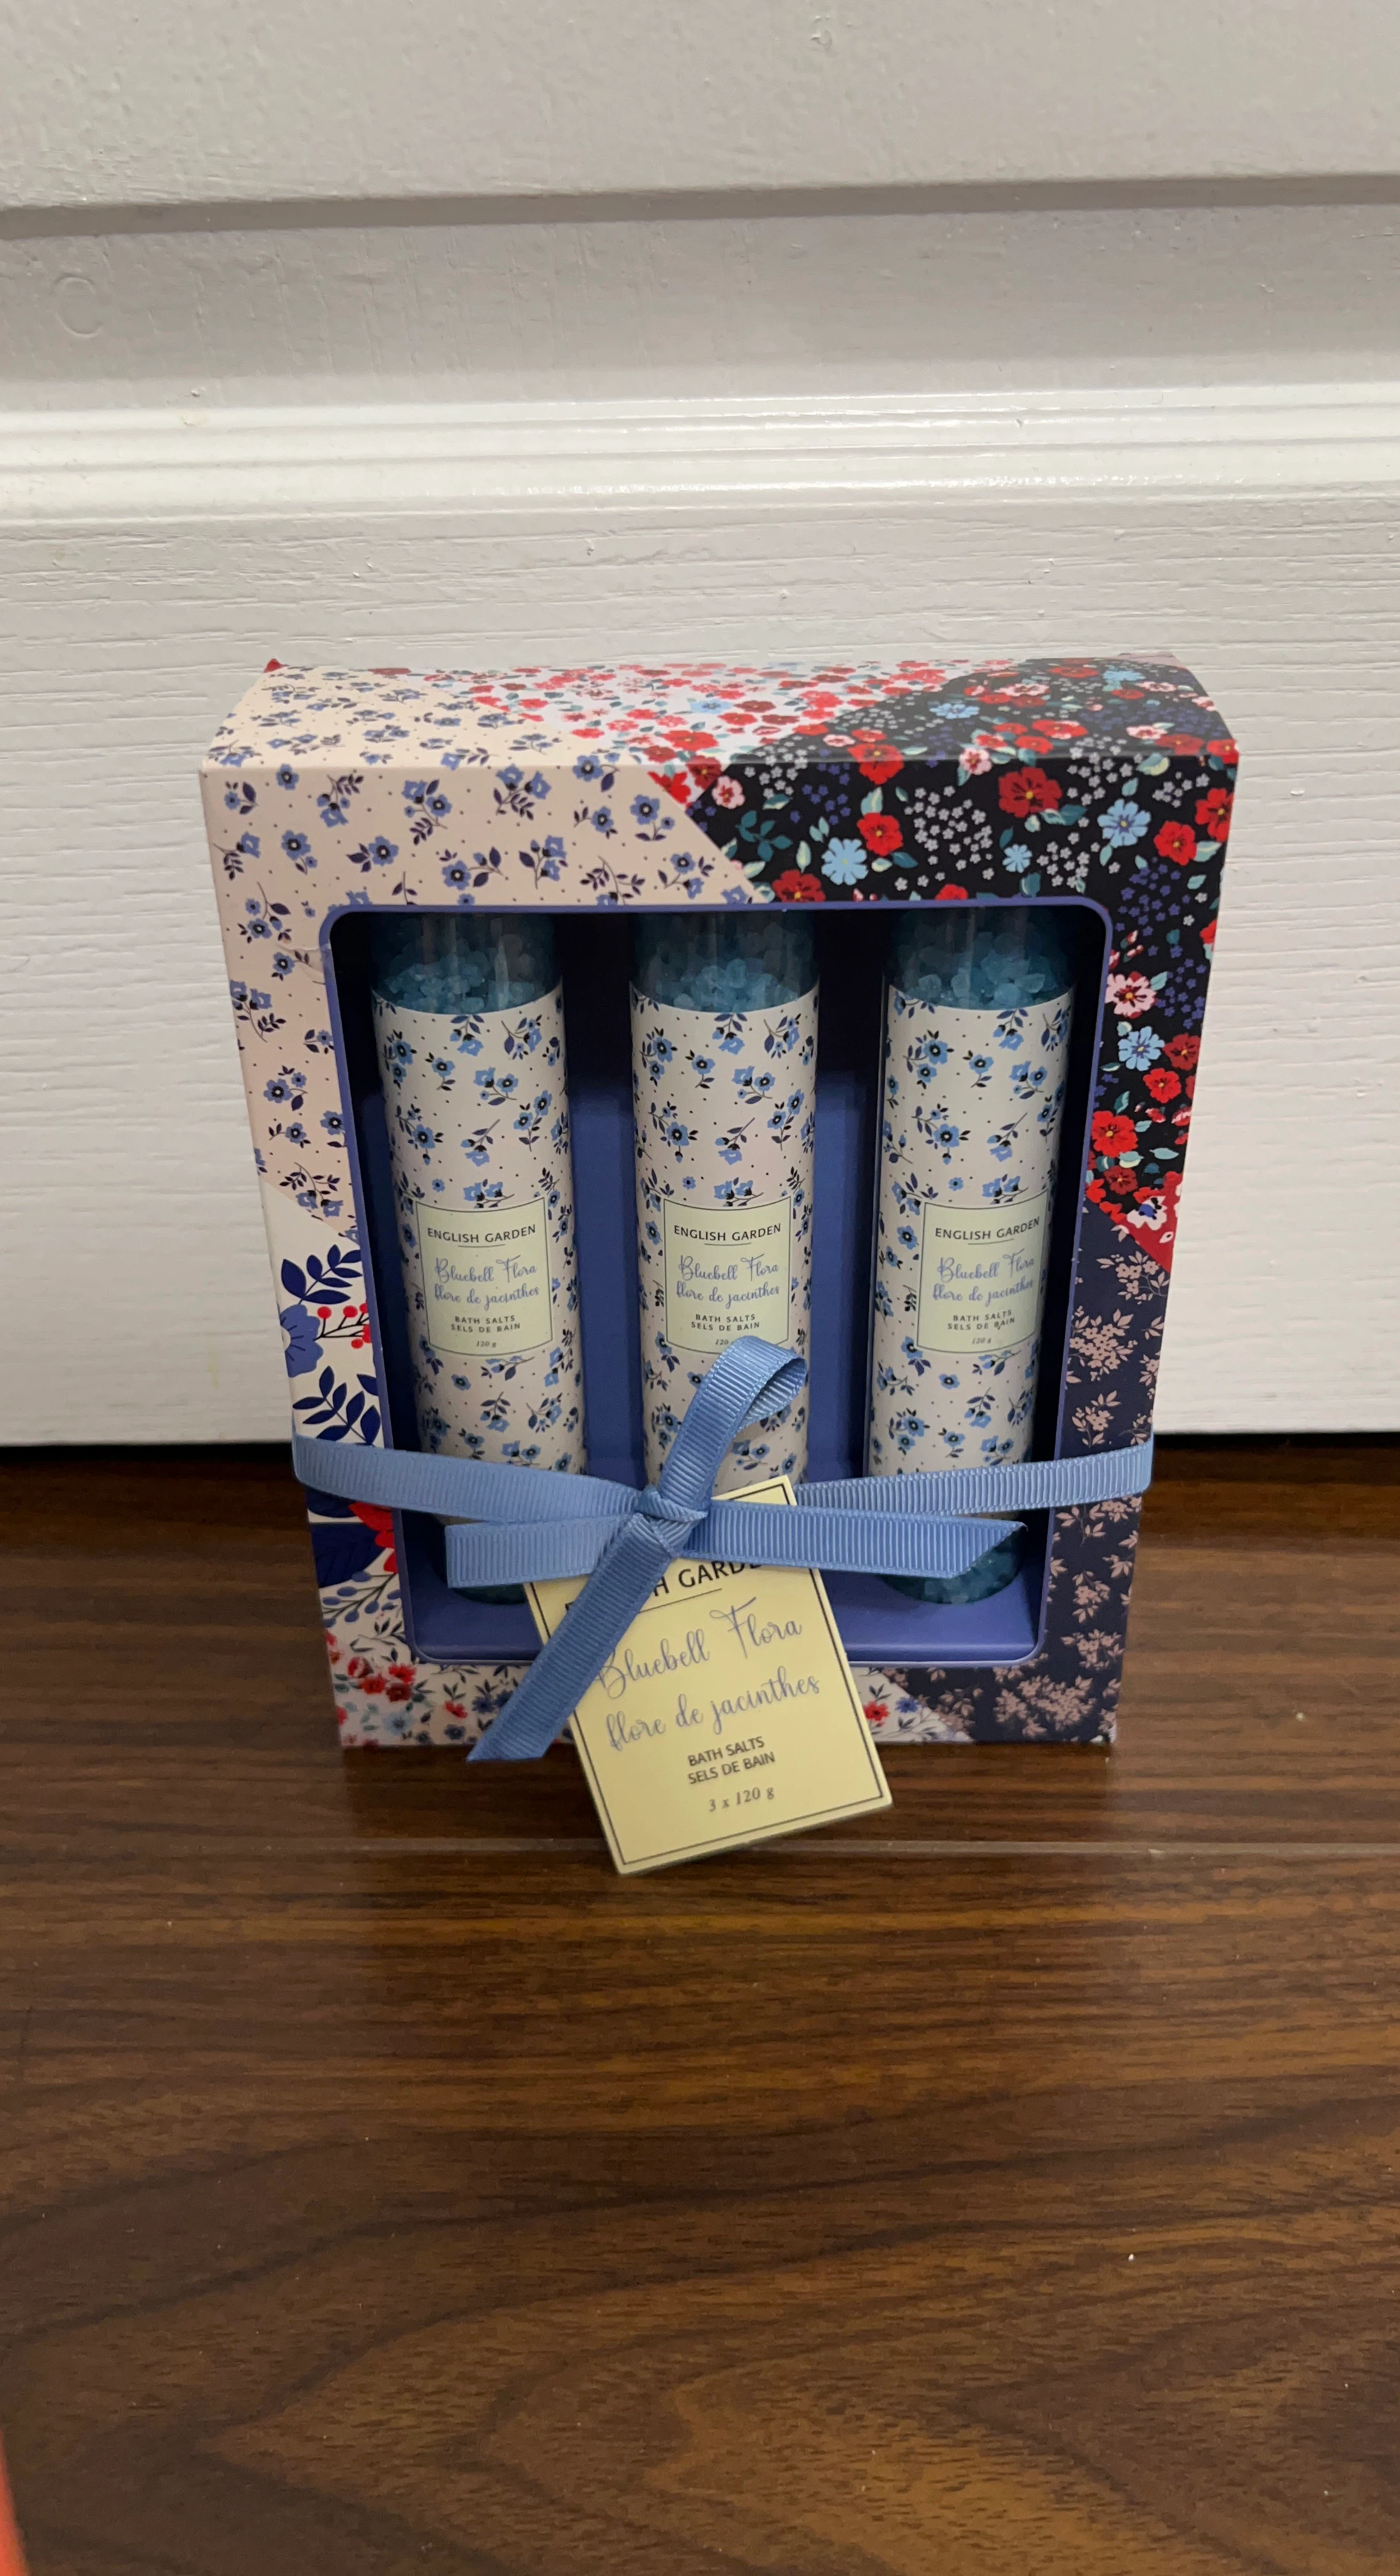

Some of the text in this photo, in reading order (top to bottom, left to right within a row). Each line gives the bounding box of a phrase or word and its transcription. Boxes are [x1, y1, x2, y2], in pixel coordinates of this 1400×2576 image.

[427, 1224, 536, 1243] ENGLISH GARDEN
[674, 1223, 781, 1241] ENGLISH GARDEN
[935, 1216, 1040, 1240] ENGLISH GARDEN
[434, 1255, 537, 1284] Bluebell Flora
[678, 1254, 780, 1282] Bluebell Flora
[936, 1248, 1035, 1283] Bluebell Flora
[466, 1288, 481, 1304] de
[708, 1287, 724, 1302] de
[726, 1282, 780, 1310] jacinthes
[968, 1286, 984, 1301] de
[455, 1315, 515, 1324] BATH SALTS
[690, 1321, 713, 1331] SELS
[737, 1322, 760, 1330] BAIN
[696, 1314, 756, 1322] BATH SALTS
[985, 1309, 1012, 1321] SALTS
[994, 1317, 1015, 1328] BAIN
[451, 1323, 473, 1333] SELS
[497, 1322, 521, 1332] BAIN
[678, 1563, 765, 1588] GARD
[709, 1597, 802, 1659] Flora
[606, 1666, 820, 1751] flore de jacinthes
[687, 1736, 765, 1767] BATH SALTS
[687, 1751, 775, 1784] SELS DE BAIN
[709, 1798, 716, 1812] 3
[721, 1798, 730, 1809] x
[736, 1787, 761, 1805] 120
